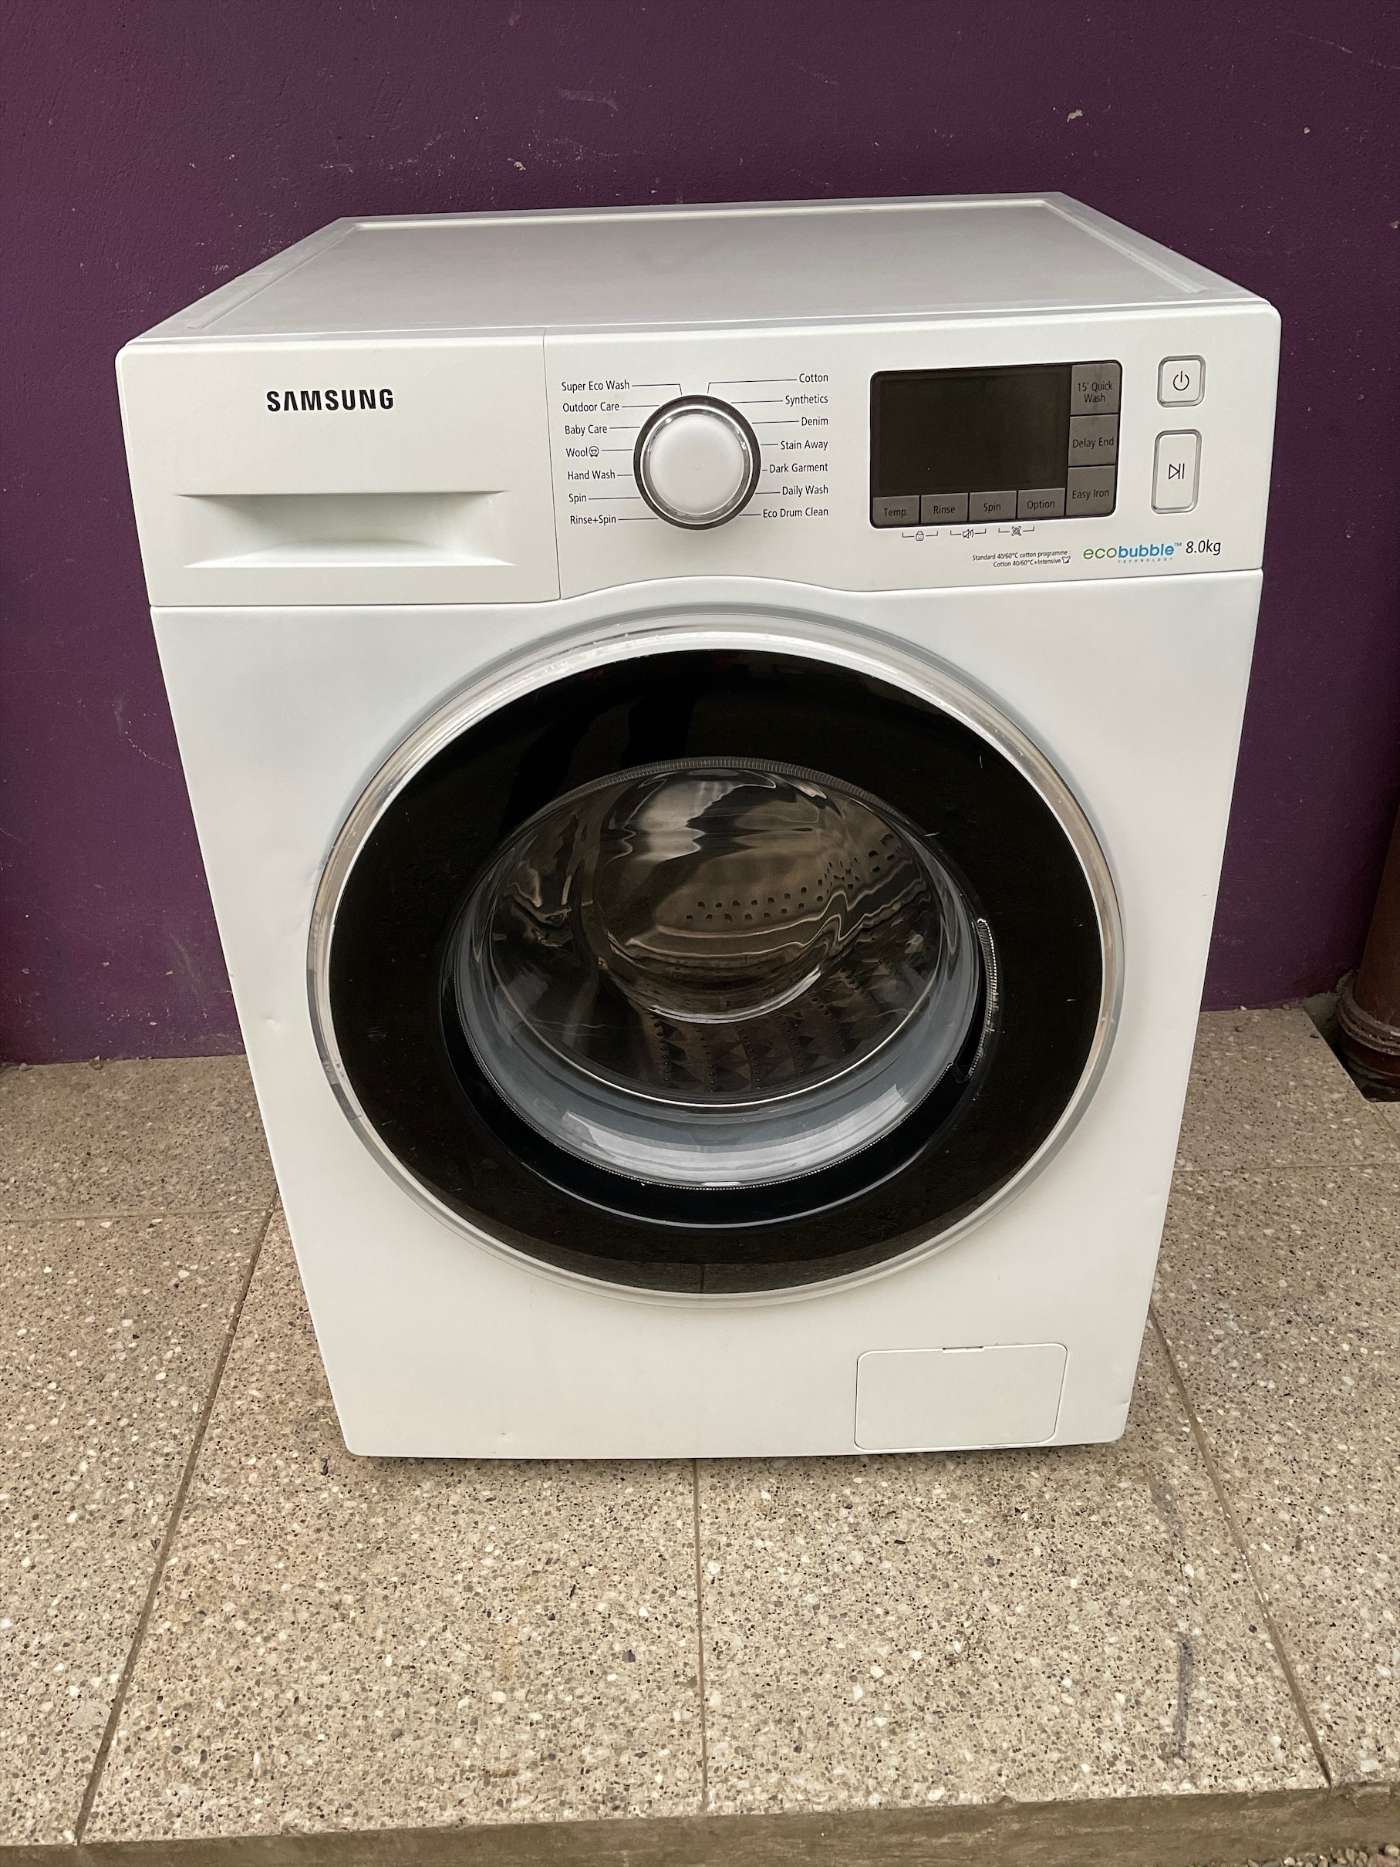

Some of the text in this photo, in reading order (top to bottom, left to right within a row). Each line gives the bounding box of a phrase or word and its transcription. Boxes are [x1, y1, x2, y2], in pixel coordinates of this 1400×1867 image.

[799, 373, 829, 383] Cotton
[561, 379, 630, 394] Super Eco Wash
[1091, 380, 1113, 392] Quick
[266, 388, 394, 412] SAMSUNG
[785, 394, 829, 407] Synthetics
[1082, 392, 1106, 403] Wash
[562, 401, 620, 412] Outdoor Care
[801, 416, 829, 426] Denim
[564, 424, 607, 437] Baby Care
[780, 440, 829, 451] Stain Away
[1072, 437, 1114, 449] Delay End
[565, 447, 588, 457] Wool
[567, 468, 616, 480] Hand Wash
[769, 463, 828, 474] Dark Garment
[782, 484, 829, 498] Daily Wash
[1072, 488, 1109, 500] Easy Iron
[568, 492, 587, 505] Spin
[933, 505, 956, 515] Rinse
[983, 503, 1002, 513] Spin
[1026, 500, 1056, 511] Option
[762, 506, 829, 518] Eco Drum Clean
[570, 513, 617, 526] Rinse+Spin
[1185, 539, 1221, 556] 8.0kg
[1037, 550, 1068, 558] programme
